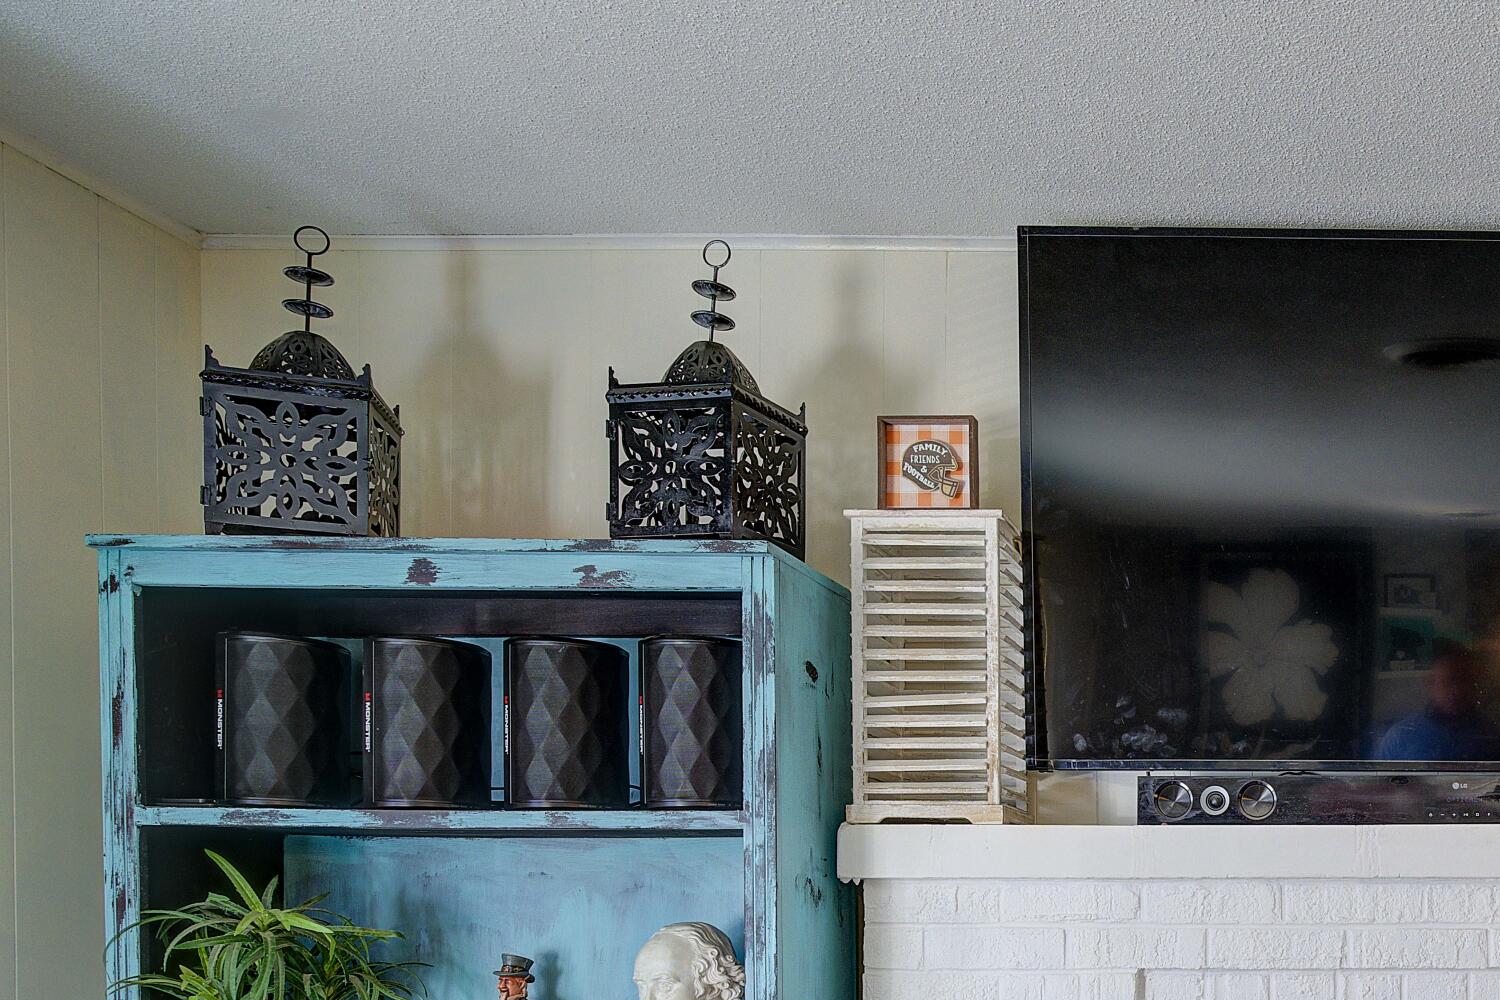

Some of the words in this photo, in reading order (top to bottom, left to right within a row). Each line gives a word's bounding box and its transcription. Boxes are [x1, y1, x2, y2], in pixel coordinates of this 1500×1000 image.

[910, 454, 940, 464] FRIENDS
[920, 465, 928, 473] &
[903, 462, 936, 489] FOOTBALL
